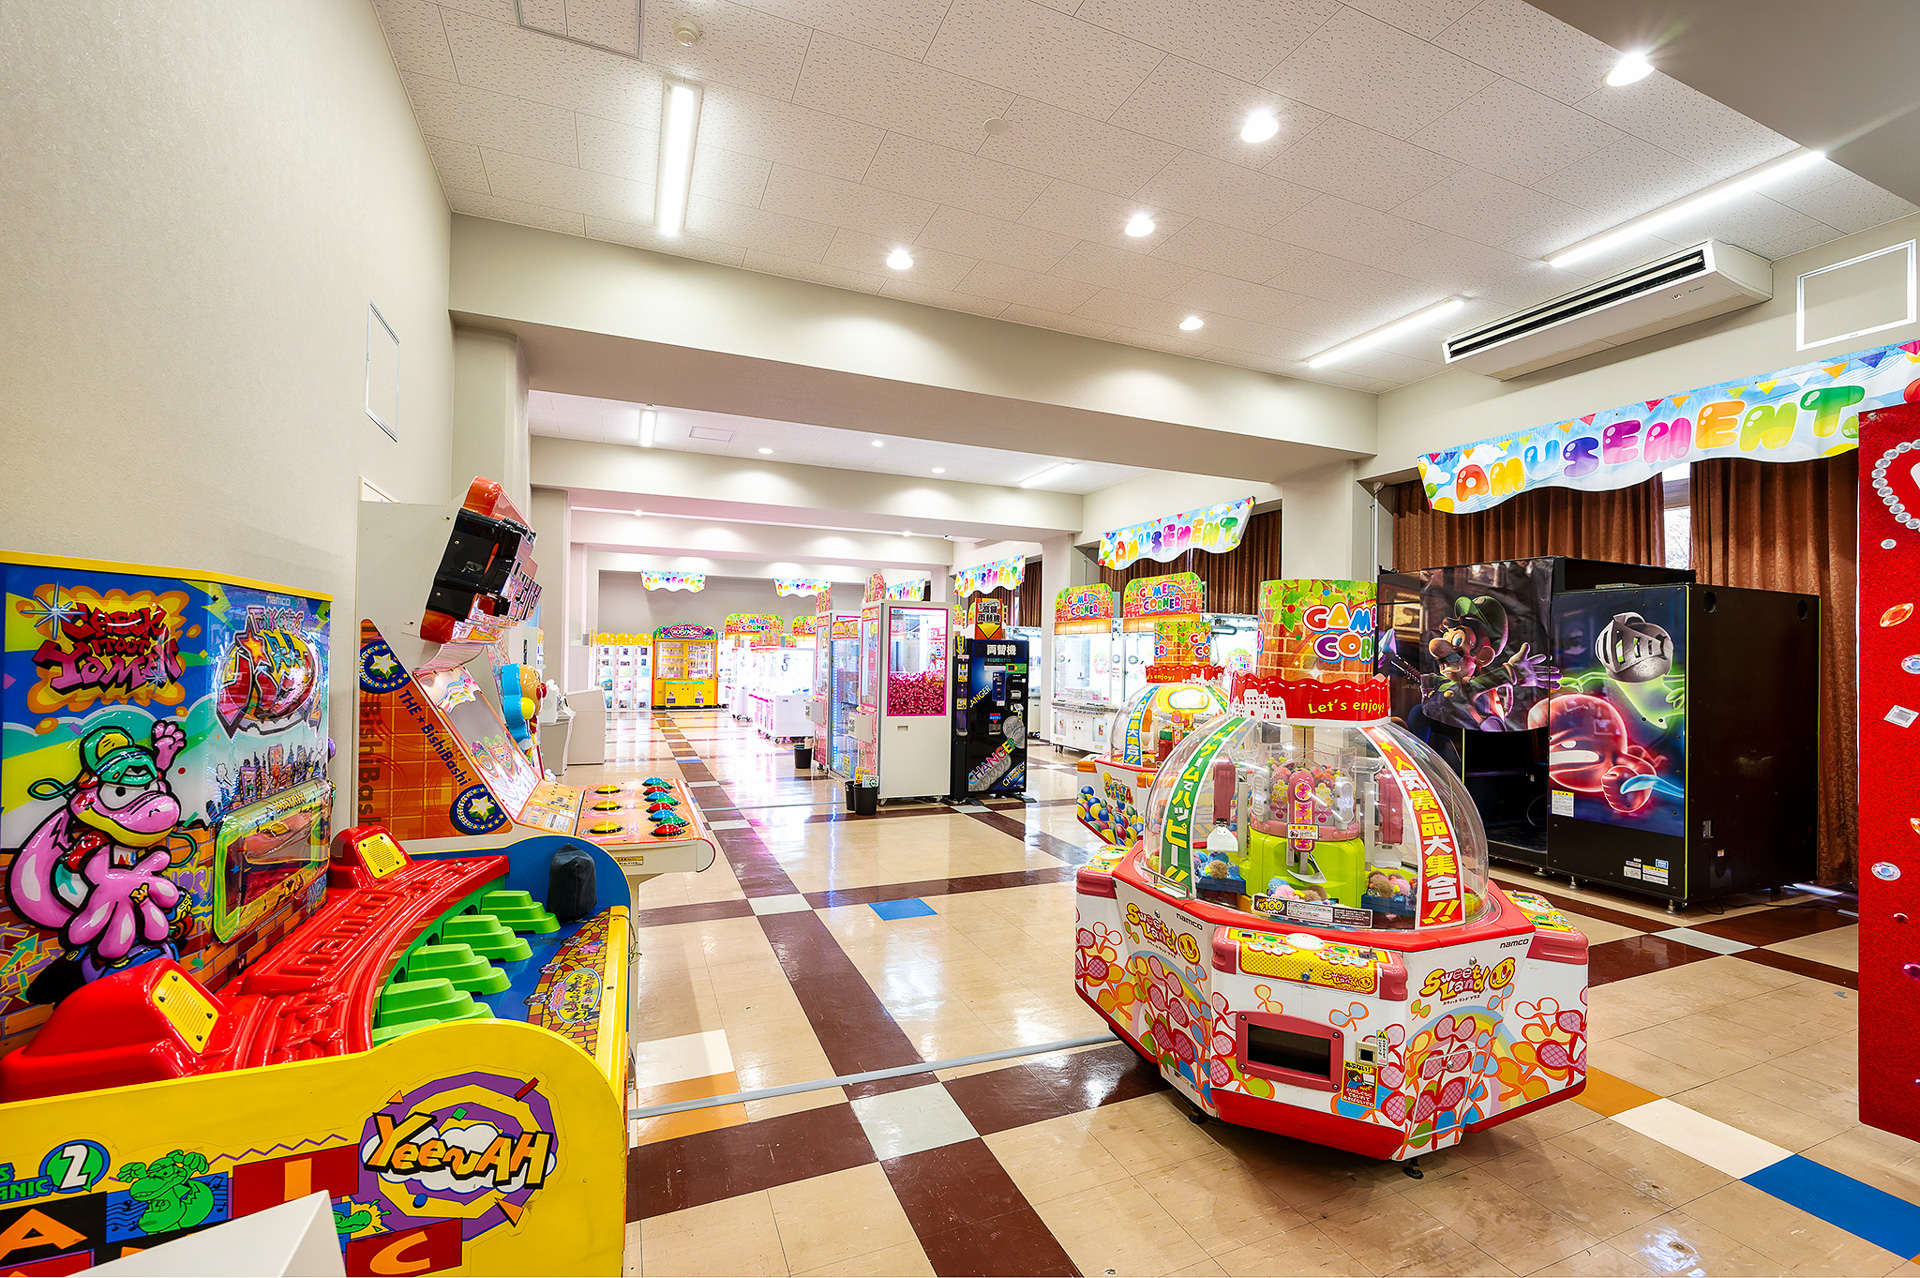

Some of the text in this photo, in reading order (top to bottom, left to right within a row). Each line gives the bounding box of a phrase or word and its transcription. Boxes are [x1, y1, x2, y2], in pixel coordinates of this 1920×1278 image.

[1455, 384, 1866, 503] AMUSEMENT
[1115, 516, 1239, 563] AMUSEMENT
[963, 566, 1018, 592] AMUSEMENT
[1139, 583, 1168, 597] GAME
[1067, 592, 1089, 605] GAME
[1071, 604, 1099, 616] CORNER
[1143, 597, 1182, 612] CORNER
[970, 685, 992, 708] ANGER
[1308, 699, 1385, 715] Let's enjoy!
[398, 689, 472, 787] THE BishiBashi
[968, 737, 1018, 785] CHANGER
[1126, 902, 1171, 938] Sweet
[1176, 913, 1203, 930] namco
[1139, 920, 1178, 956] Land
[1499, 938, 1529, 949] namco
[1419, 964, 1484, 998] Sweet
[1440, 966, 1491, 1001] Land
[60, 1143, 90, 1191] 2
[370, 1230, 430, 1275] C
